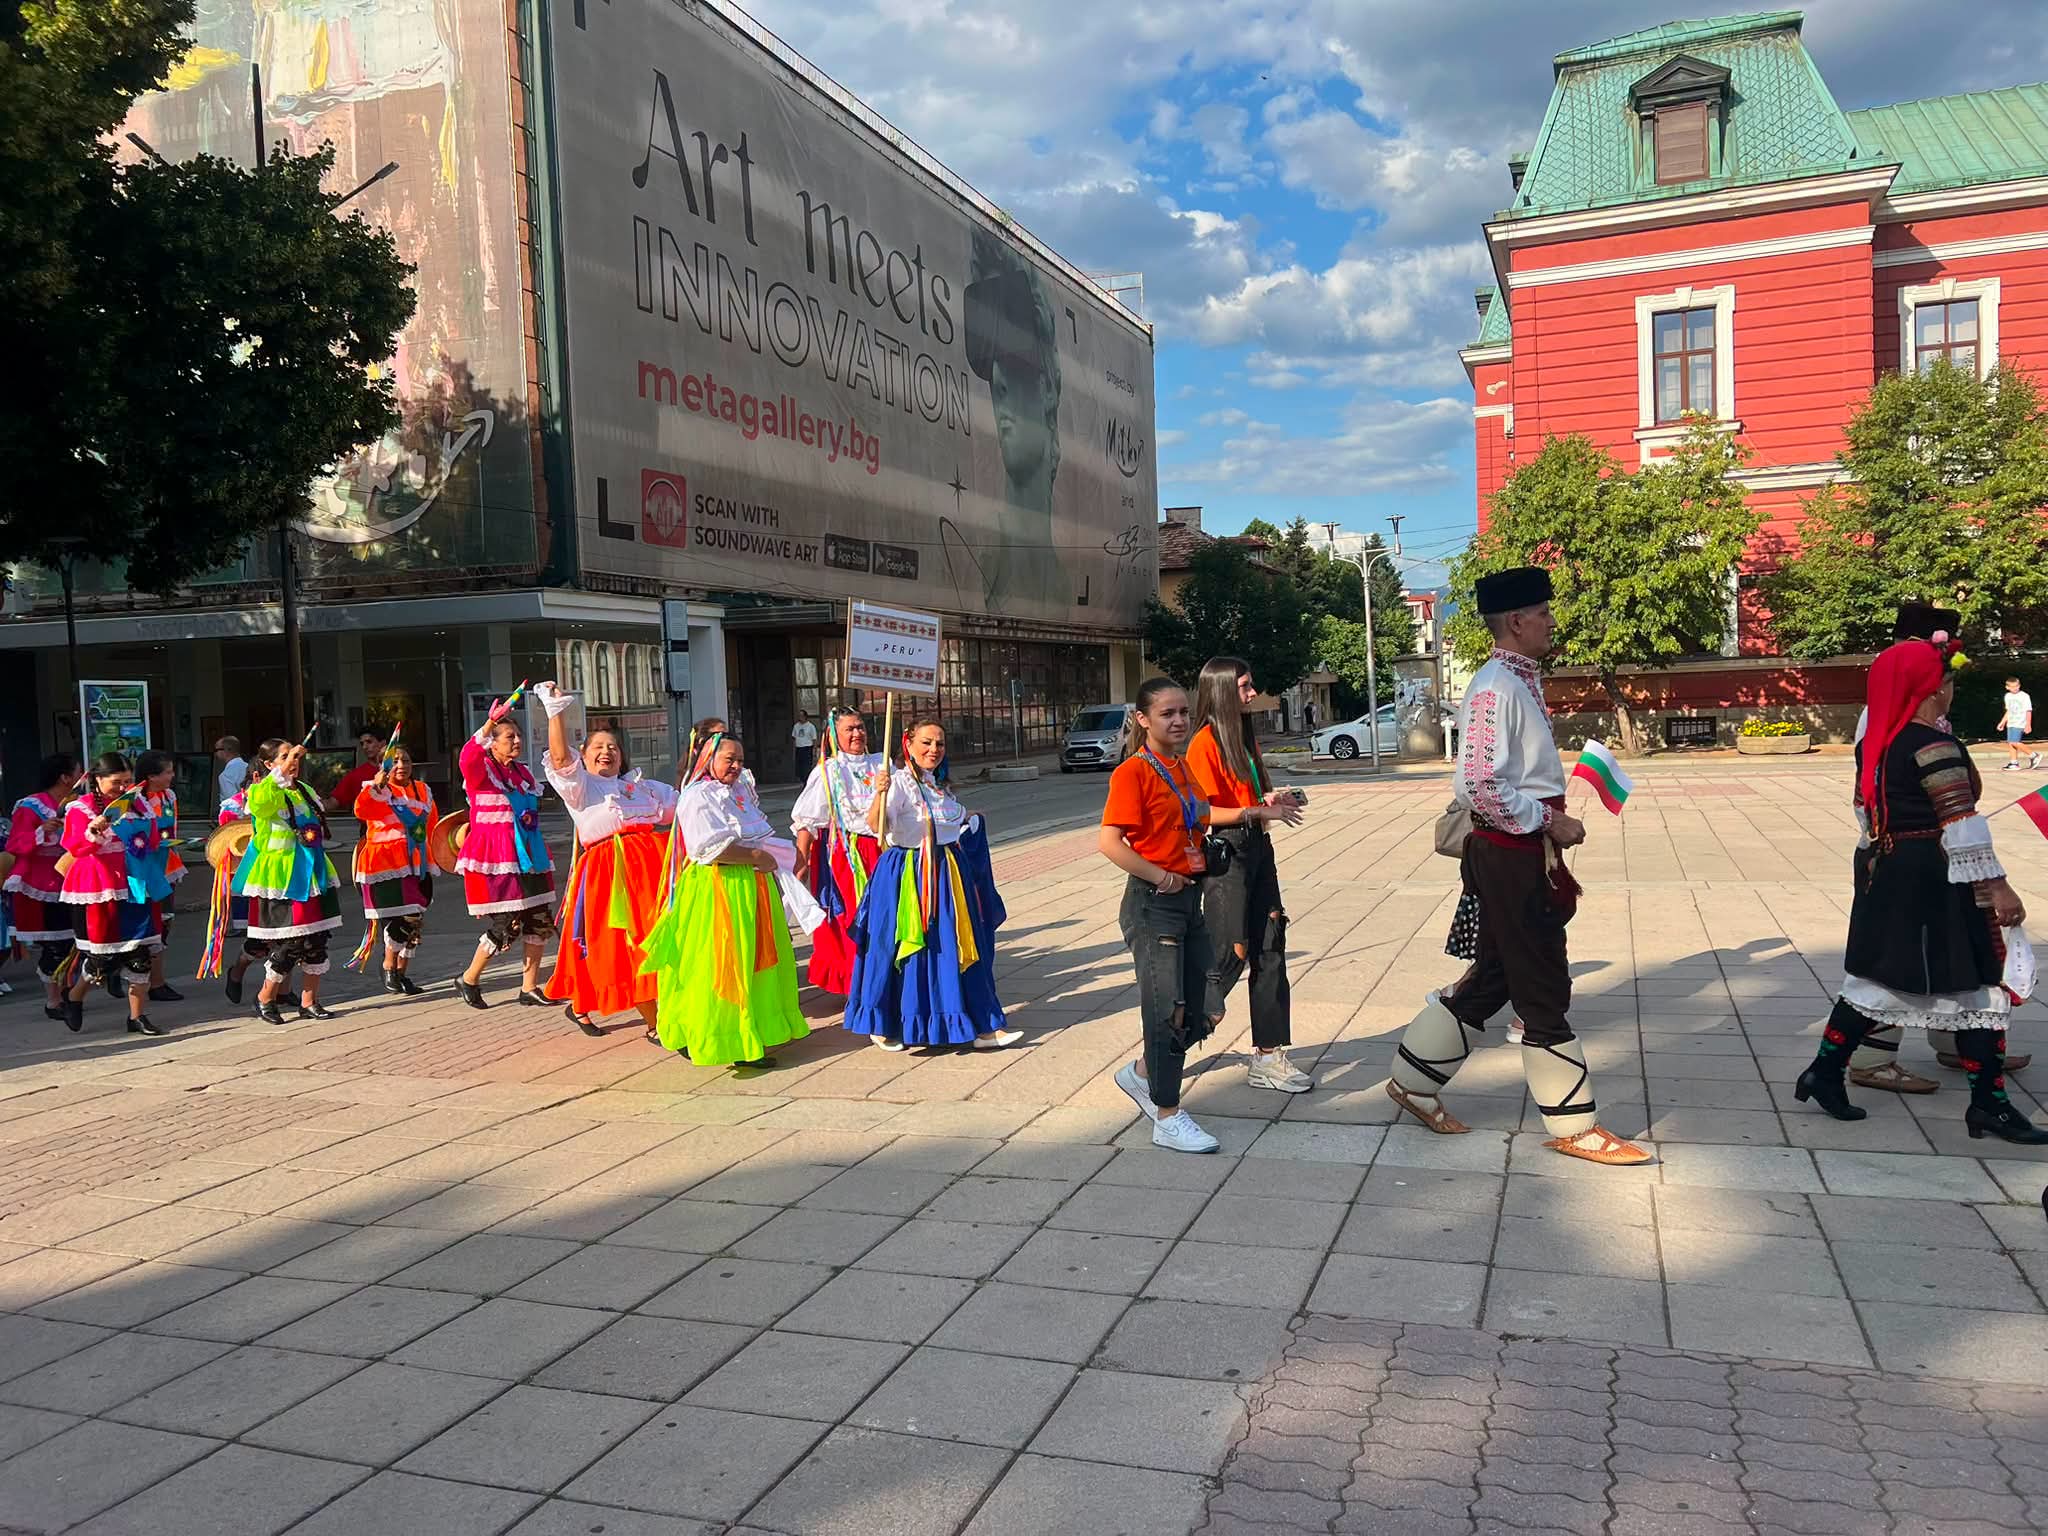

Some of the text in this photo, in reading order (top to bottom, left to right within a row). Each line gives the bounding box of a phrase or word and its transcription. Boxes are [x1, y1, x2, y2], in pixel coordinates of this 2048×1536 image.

[632, 68, 954, 345] Art meets
[633, 215, 971, 436] INNOVATION
[637, 360, 880, 475] metagallery.bg
[694, 495, 779, 529] SCAN WITH
[1121, 495, 1134, 509] and
[694, 526, 819, 564] SOUNDWAVE ART
